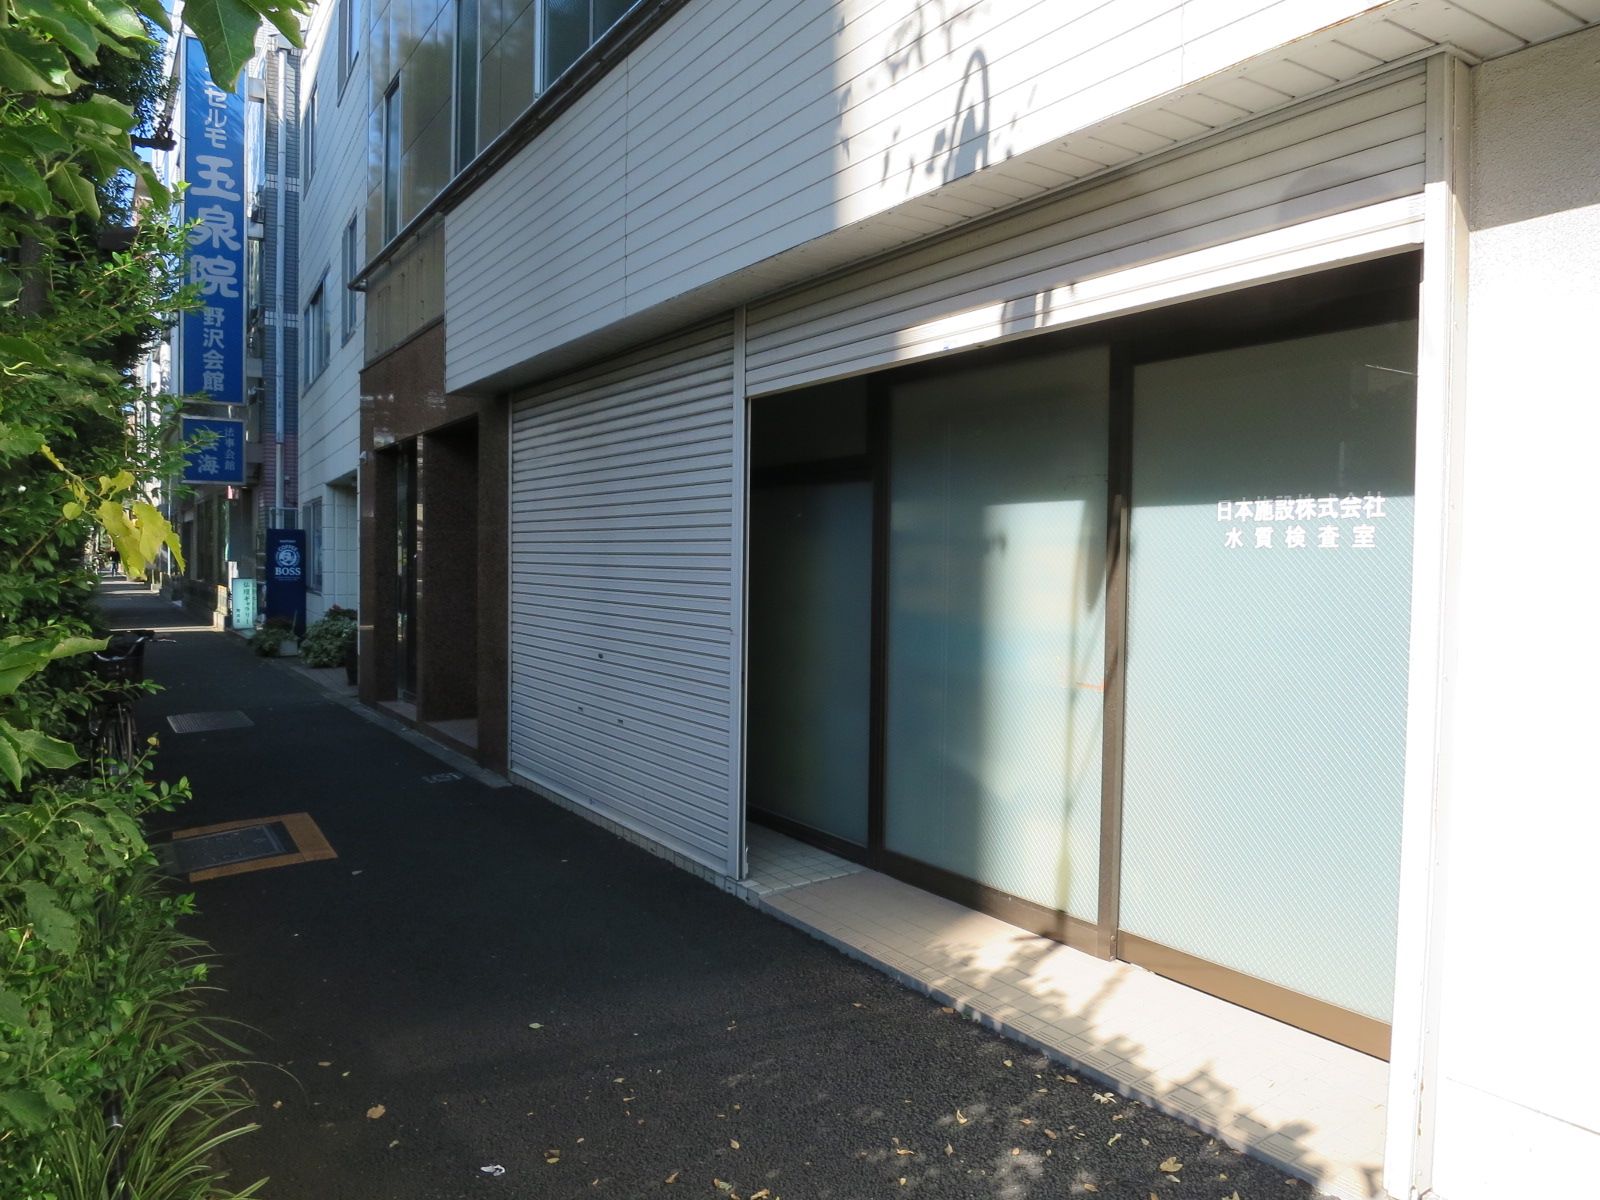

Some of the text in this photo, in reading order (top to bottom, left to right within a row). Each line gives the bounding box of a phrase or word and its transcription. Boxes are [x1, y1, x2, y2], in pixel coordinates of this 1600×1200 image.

[187, 155, 241, 298] 玉泉院
[202, 306, 225, 392] 野沢会館
[1217, 491, 1386, 521] 日本施設株式会社
[1224, 523, 1377, 549] 水質検査室
[274, 567, 302, 576] BOSS
